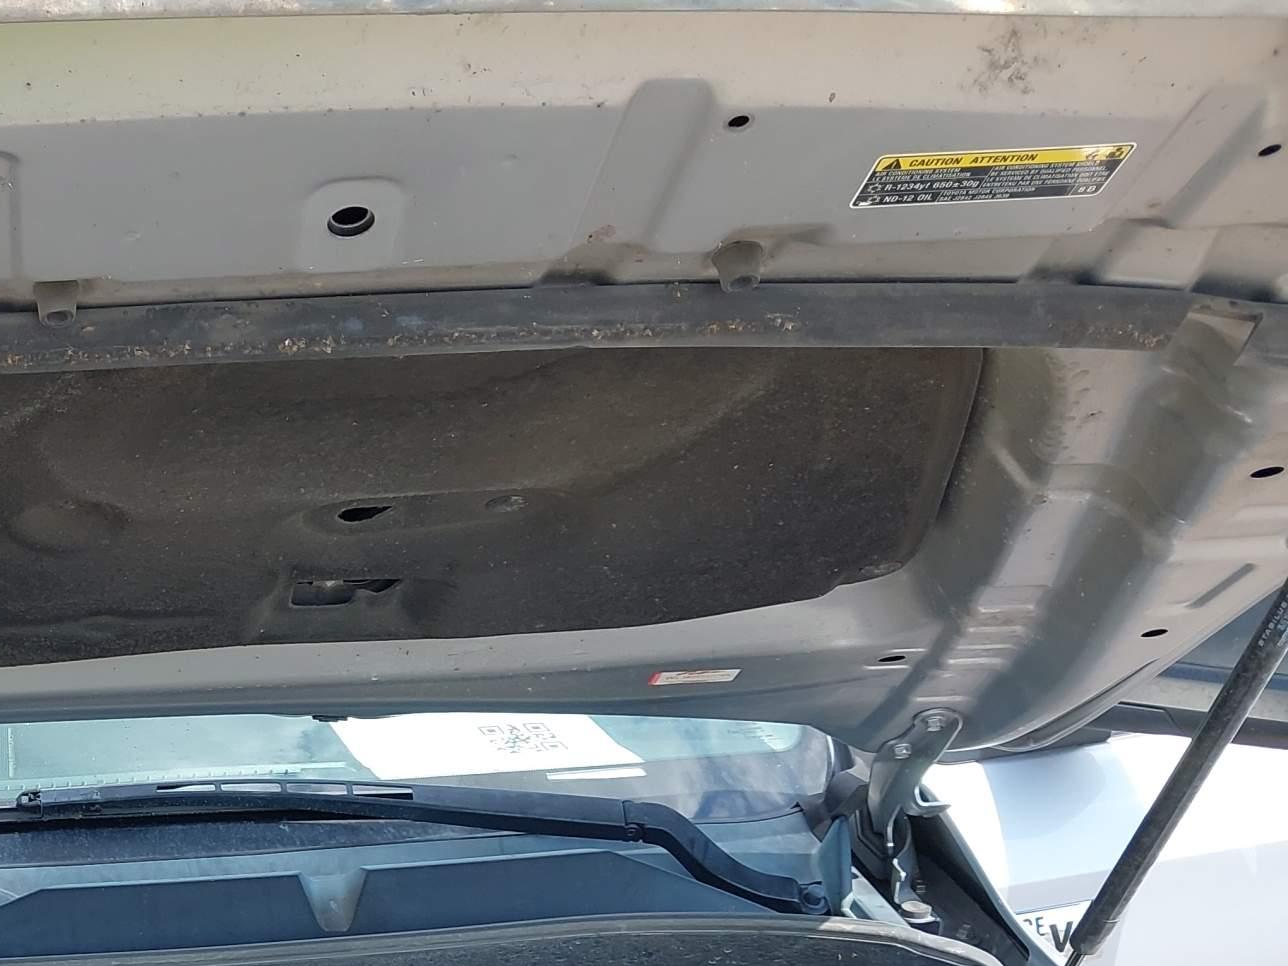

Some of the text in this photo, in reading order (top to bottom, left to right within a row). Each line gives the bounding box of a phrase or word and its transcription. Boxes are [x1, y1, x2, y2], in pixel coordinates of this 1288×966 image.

[908, 153, 1039, 167] CAUTION ATTENTION
[884, 181, 929, 191] R-1234yf
[882, 193, 933, 203] ND-12 OIL
